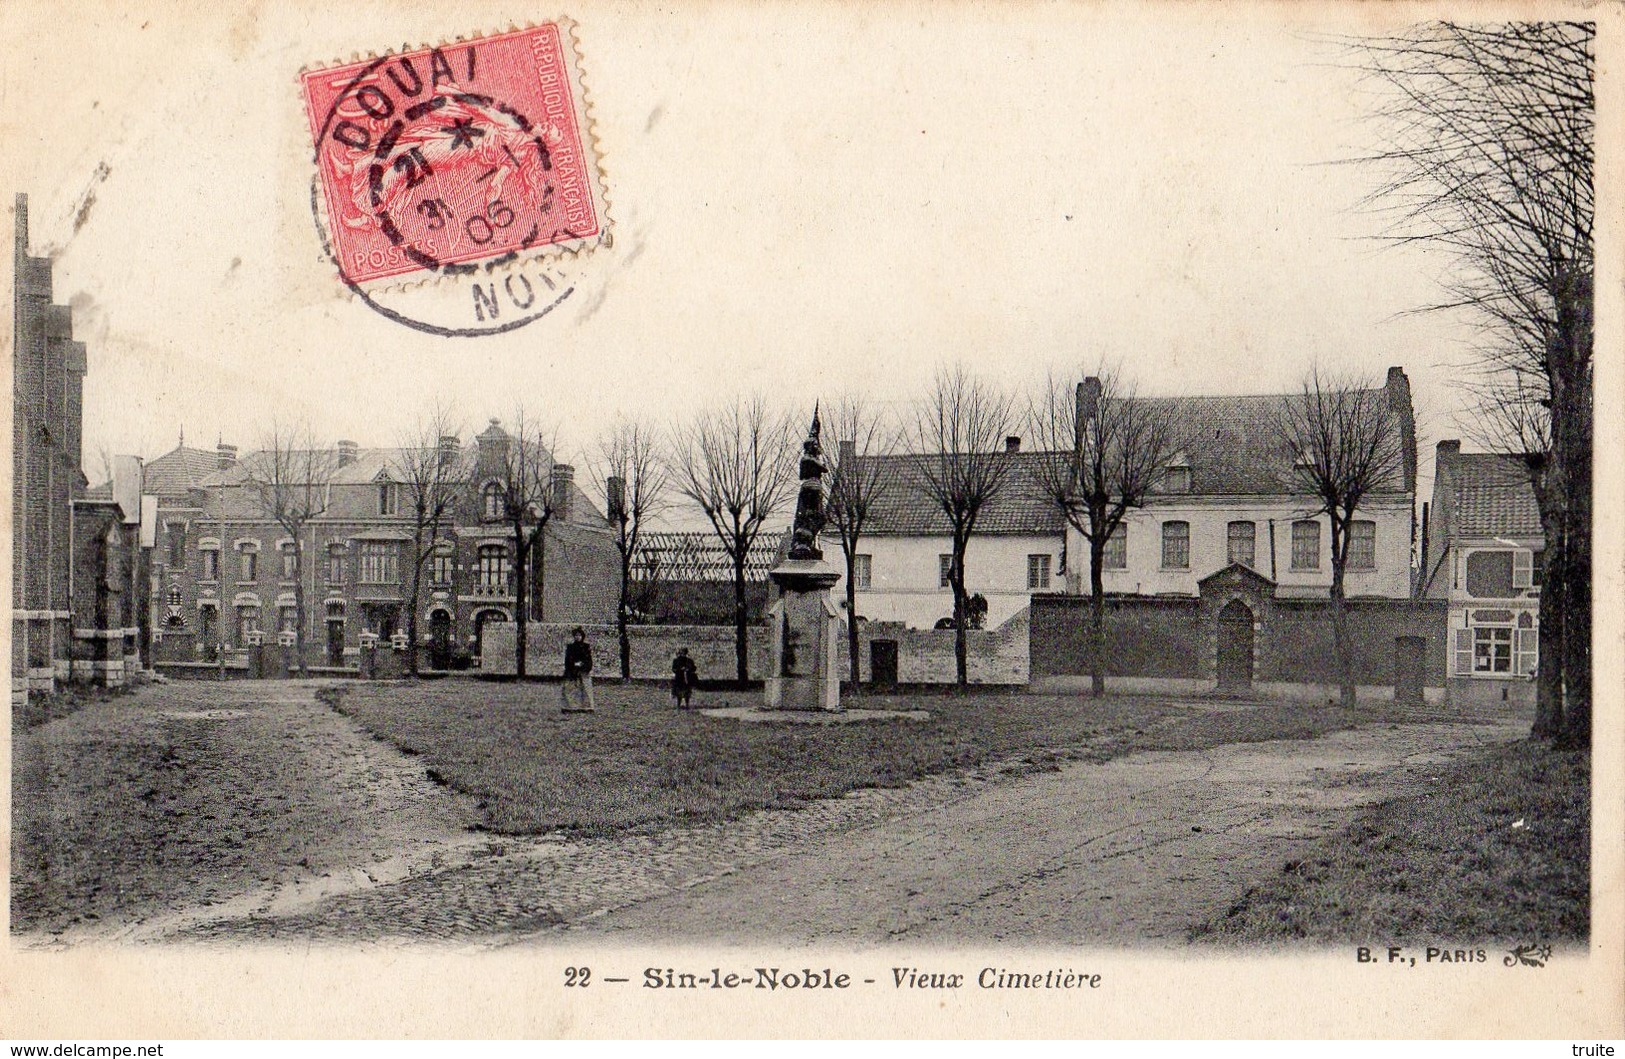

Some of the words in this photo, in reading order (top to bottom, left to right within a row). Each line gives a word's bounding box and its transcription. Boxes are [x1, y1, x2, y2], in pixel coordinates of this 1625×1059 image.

[332, 47, 476, 151] DOUAI
[393, 147, 433, 189] 21
[354, 238, 439, 270] POSTES
